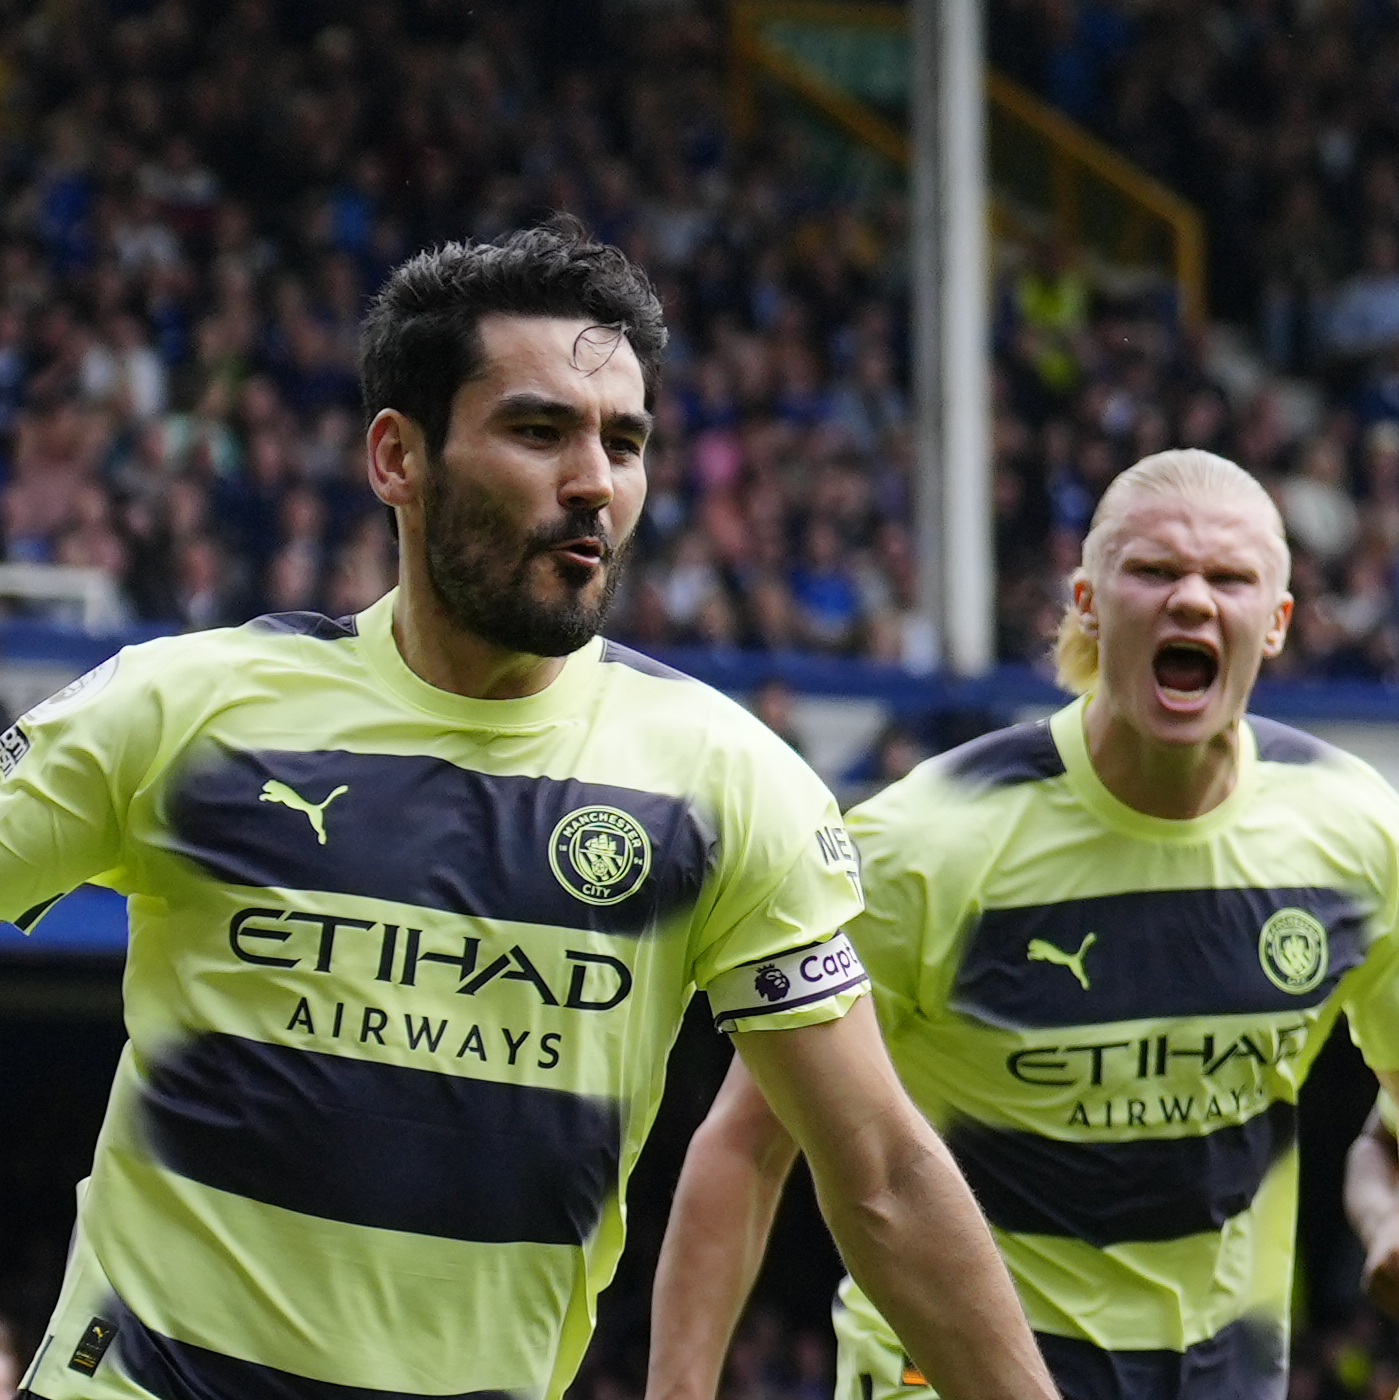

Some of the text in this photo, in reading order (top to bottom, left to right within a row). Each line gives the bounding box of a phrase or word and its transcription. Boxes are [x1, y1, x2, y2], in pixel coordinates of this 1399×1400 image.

[562, 812, 642, 848] MANCHESTER
[582, 883, 612, 898] CITY
[228, 906, 633, 1012] ETIHAD
[286, 996, 562, 1070] AIRWAYS
